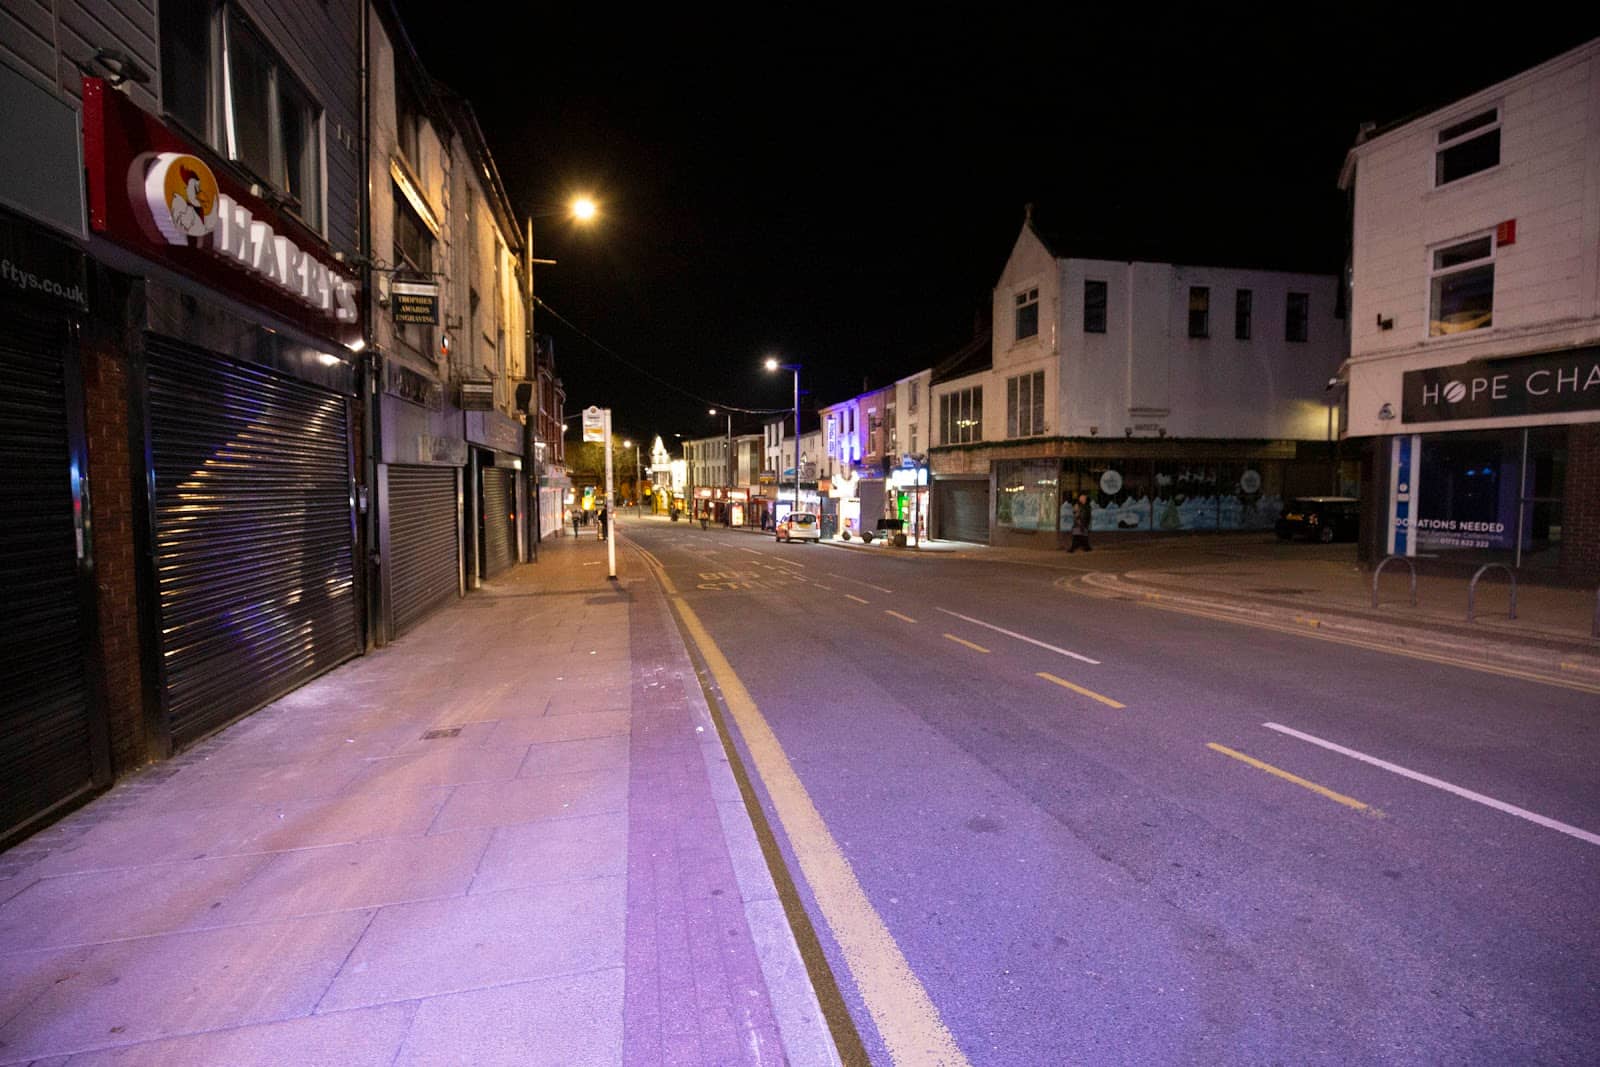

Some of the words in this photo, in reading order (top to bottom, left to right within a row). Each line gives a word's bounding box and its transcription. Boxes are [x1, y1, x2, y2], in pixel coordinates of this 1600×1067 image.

[400, 305, 430, 313] AWARDS
[1422, 374, 1509, 406] HOPE
[1392, 518, 1456, 530] DOATIONS
[1460, 521, 1504, 533] NEEDED
